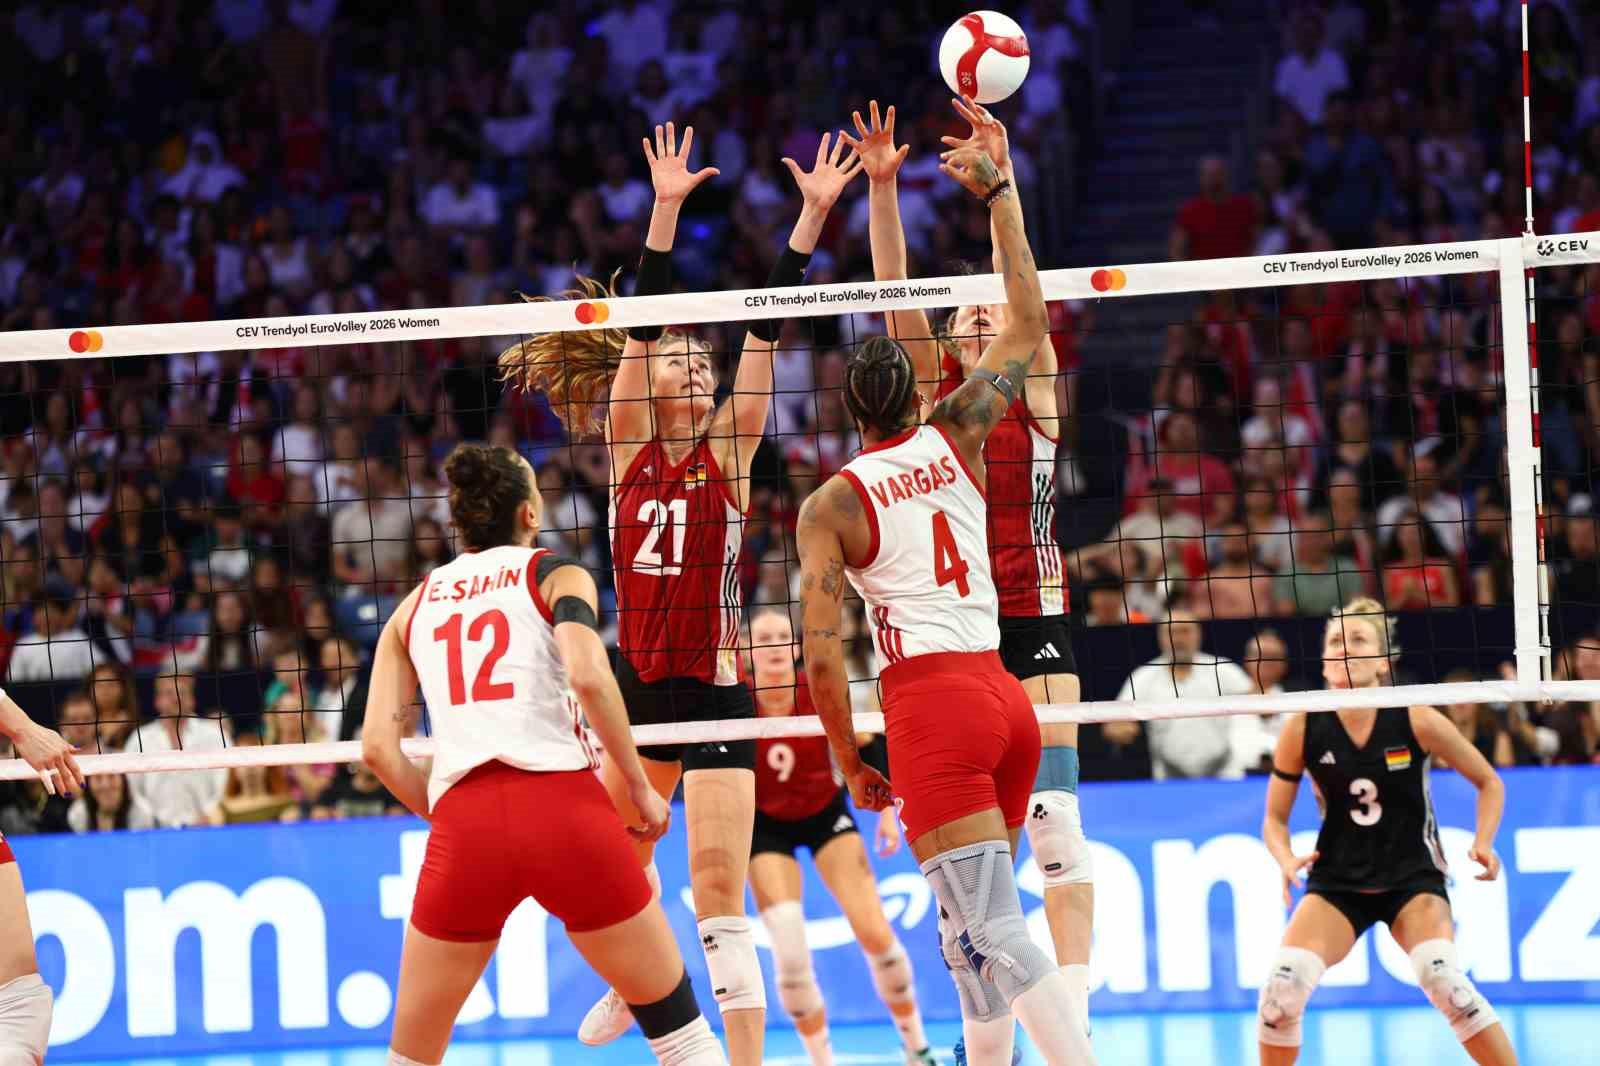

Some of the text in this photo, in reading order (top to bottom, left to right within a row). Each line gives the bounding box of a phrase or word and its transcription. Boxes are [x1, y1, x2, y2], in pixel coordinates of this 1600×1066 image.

[1264, 251, 1478, 273] CEV Trendyol EuroVolley 2026 Women
[1558, 240, 1588, 252] CEV
[745, 287, 950, 307] CEV Trendyol EuroVolley 2026 Women
[236, 318, 439, 337] CEV Trendyol EuroVolley 2026 Women
[870, 455, 957, 508] VARGAS
[632, 499, 688, 576] 21
[932, 510, 970, 598] 4
[433, 608, 514, 706] 12
[767, 743, 795, 783] 9
[1349, 778, 1382, 826] 3
